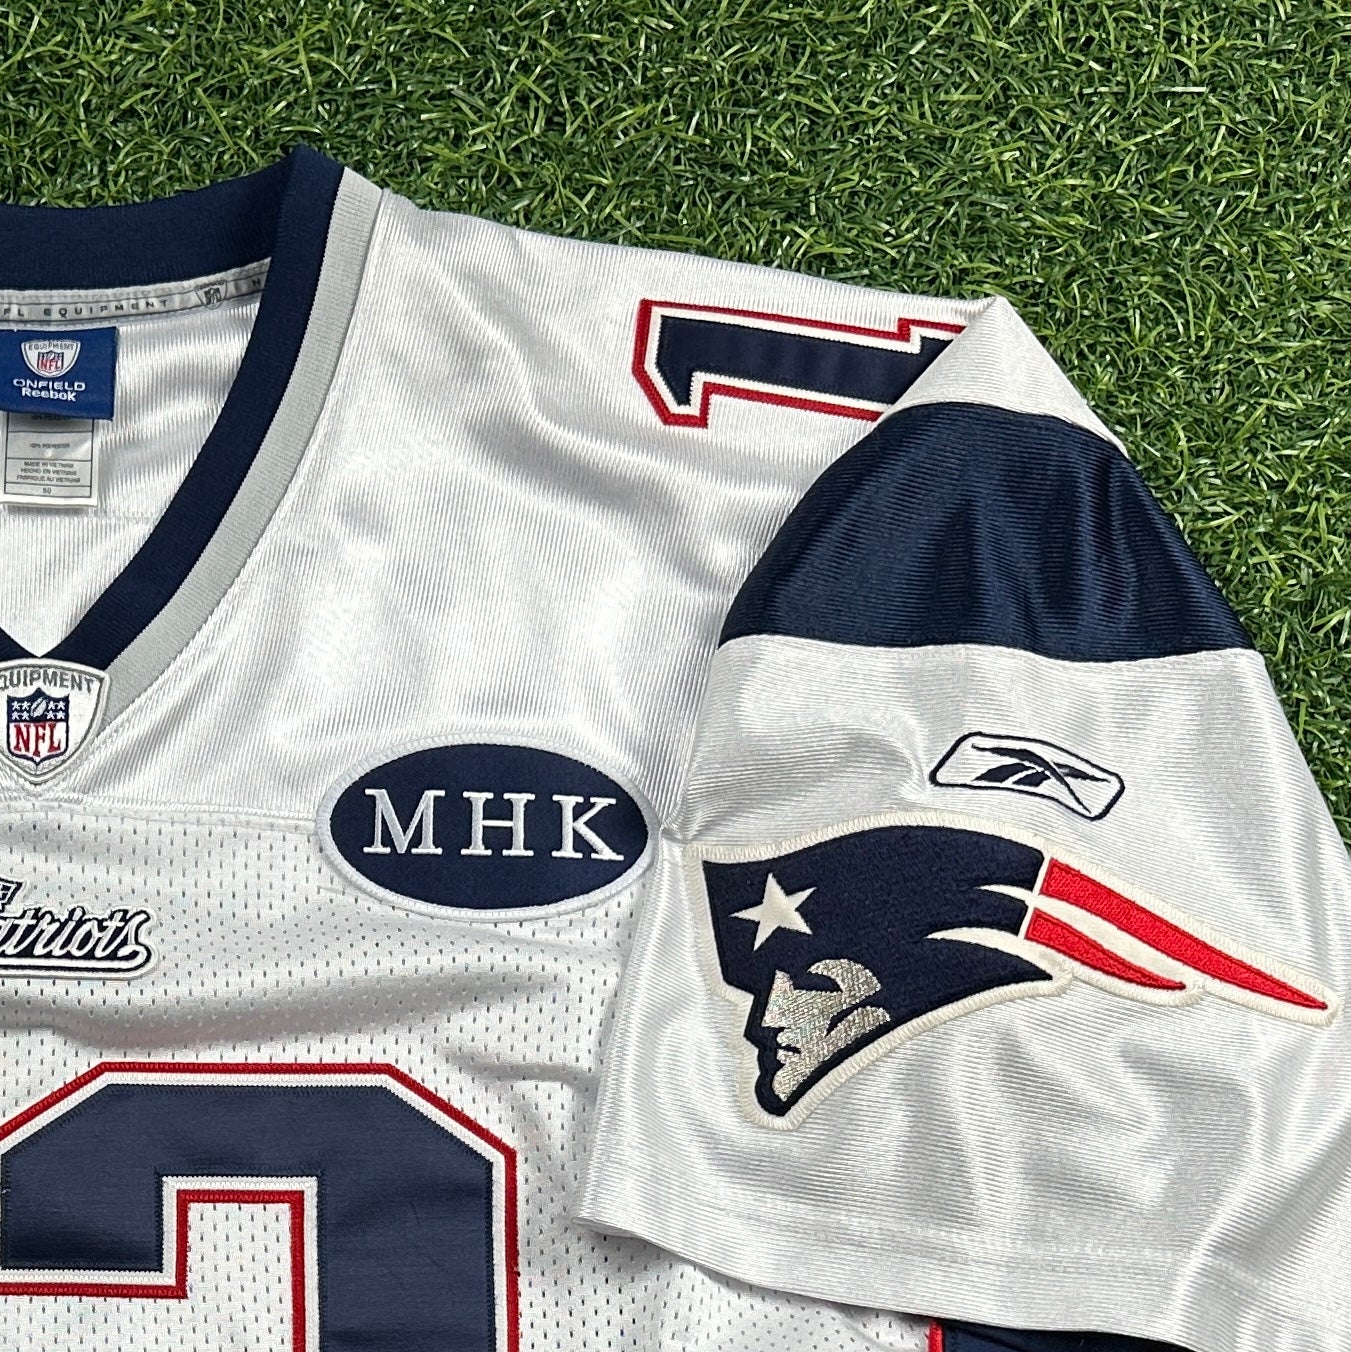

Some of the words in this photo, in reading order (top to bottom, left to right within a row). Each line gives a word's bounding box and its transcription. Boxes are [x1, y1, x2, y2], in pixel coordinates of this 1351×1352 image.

[44, 299, 168, 316] EQUIPMENT
[28, 340, 75, 351] EQUIPMENT
[39, 358, 62, 373] NFL
[13, 378, 86, 391] ONFIELD
[21, 387, 76, 401] Reebok
[13, 722, 62, 758] NFL
